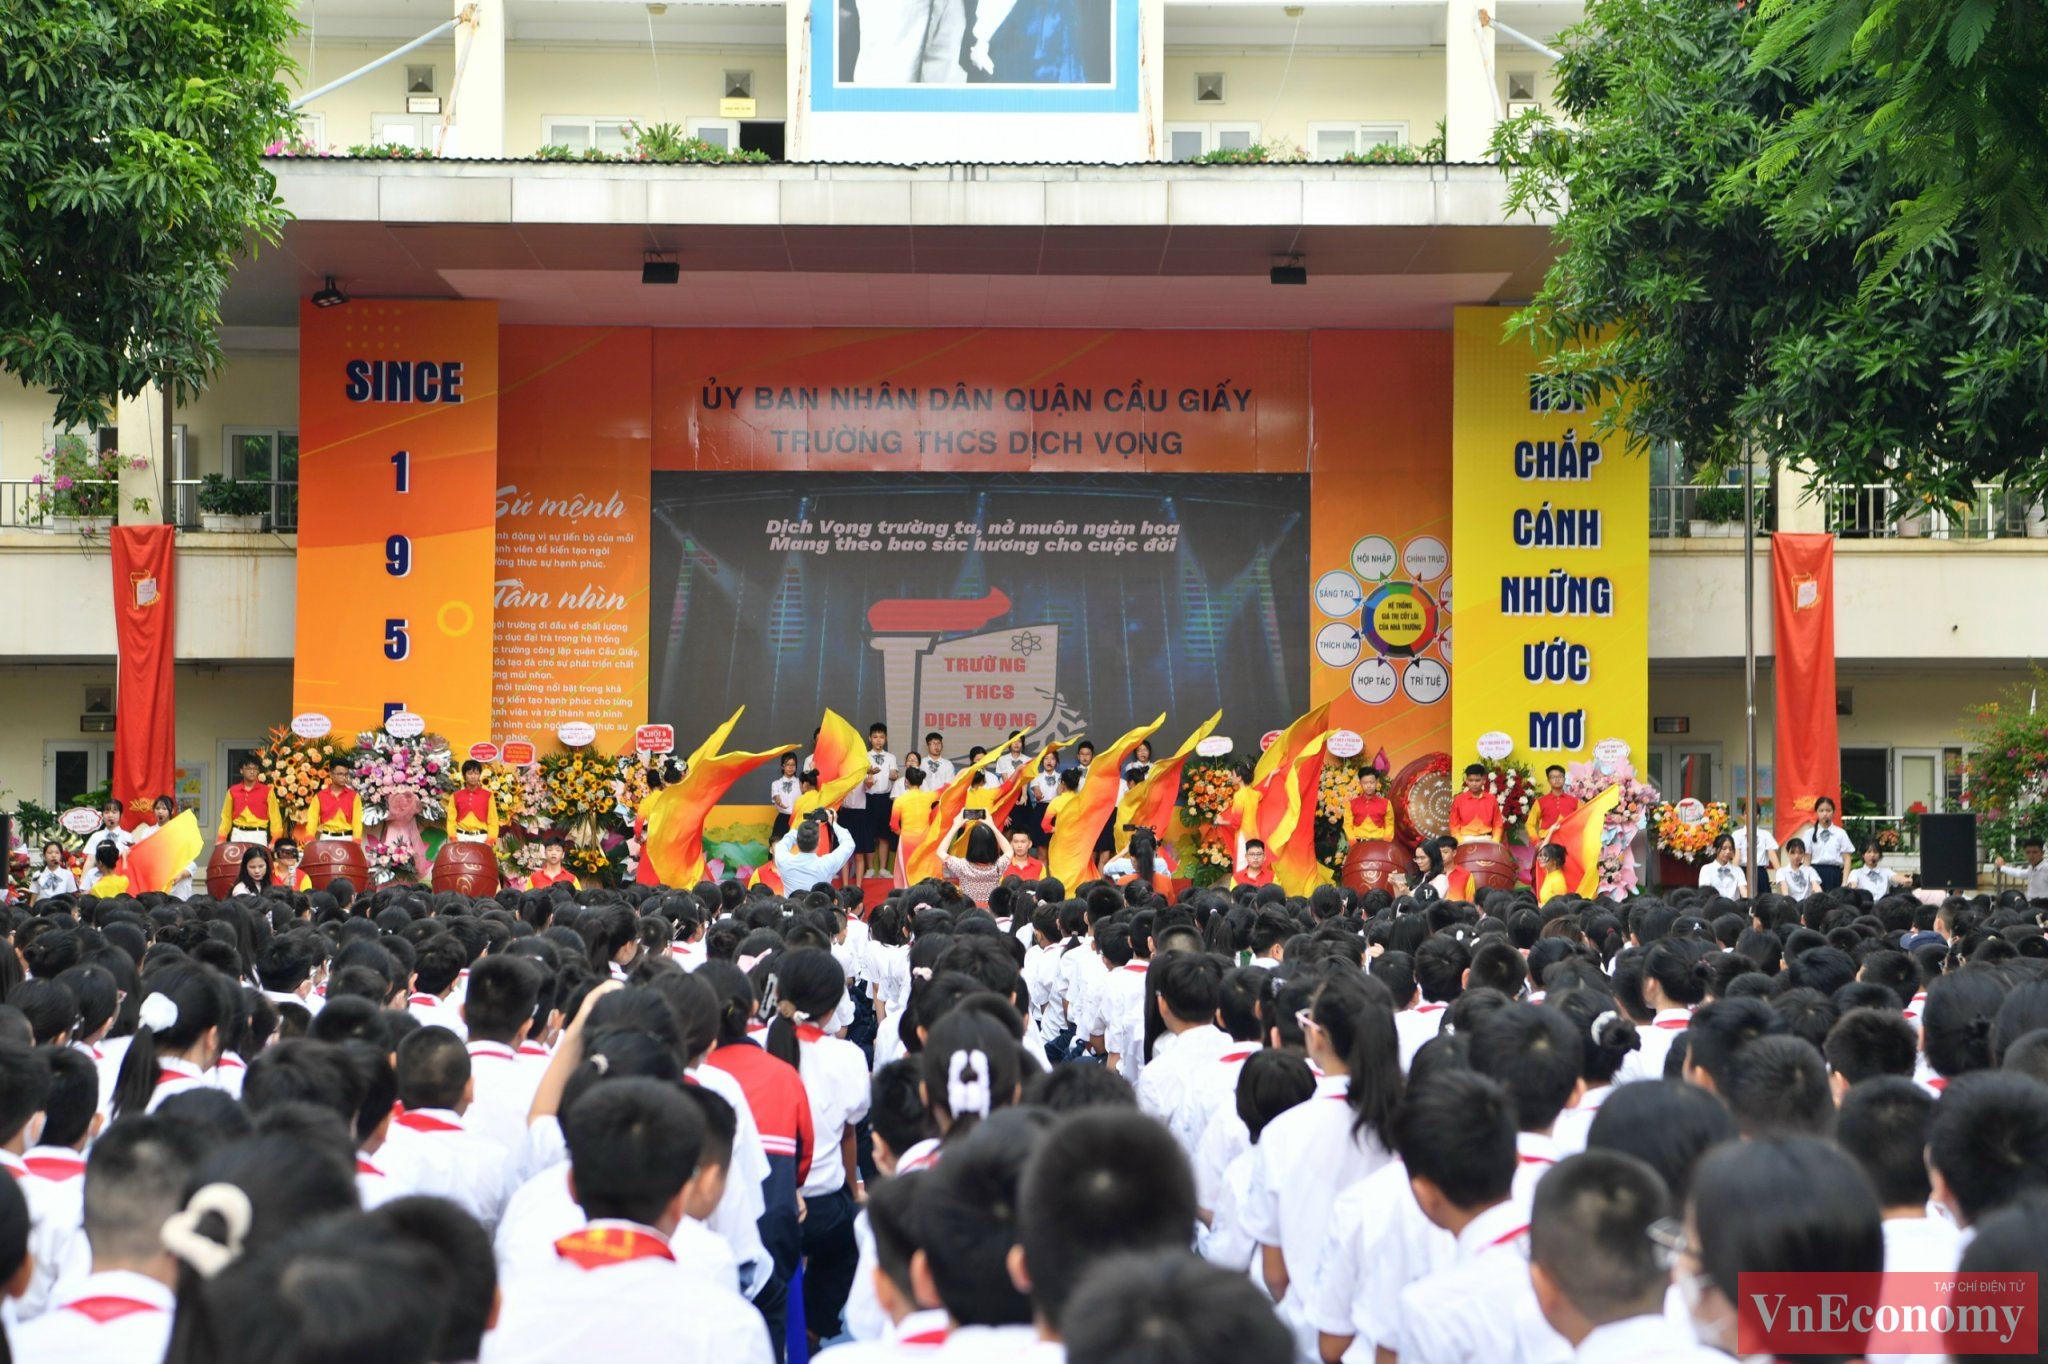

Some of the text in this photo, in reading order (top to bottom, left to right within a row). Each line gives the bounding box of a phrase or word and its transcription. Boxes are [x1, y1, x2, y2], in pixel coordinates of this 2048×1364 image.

[346, 359, 464, 404] SINCE
[702, 377, 1252, 416] ỦY BAN NHÂN DÂN QUẬN CẦU GIẤY
[770, 424, 1182, 459] TRƯỜNG THCS DỊCH VỌNG
[1514, 428, 1602, 480] CHẮP
[538, 489, 626, 524] mệnh
[766, 519, 1180, 538] Dịch Vọng trường ta, nở muôn ngàn hoa
[1513, 501, 1601, 549] CÁNH
[512, 532, 536, 543] động
[769, 533, 1178, 555] Mang theo bao sắc hương cho cuộc đời
[555, 558, 577, 569] hạnh
[1356, 553, 1392, 563] HỘI NHẬP
[1406, 554, 1426, 563] CHÍNH
[494, 578, 627, 610] Tầm nhìn
[1319, 587, 1338, 598] SÁNG
[1501, 568, 1613, 616] NHỮNG
[1320, 641, 1340, 649] THÍCH
[944, 654, 1026, 672] TRƯỜNG
[1523, 636, 1590, 685] ƯỚC
[1358, 676, 1391, 686] HỢP TÁC
[1410, 676, 1442, 687] TRÍ TUỆ
[963, 684, 1015, 699] THCS
[924, 712, 1037, 731] DỊCH VỌNG
[1529, 709, 1585, 751] MƠ
